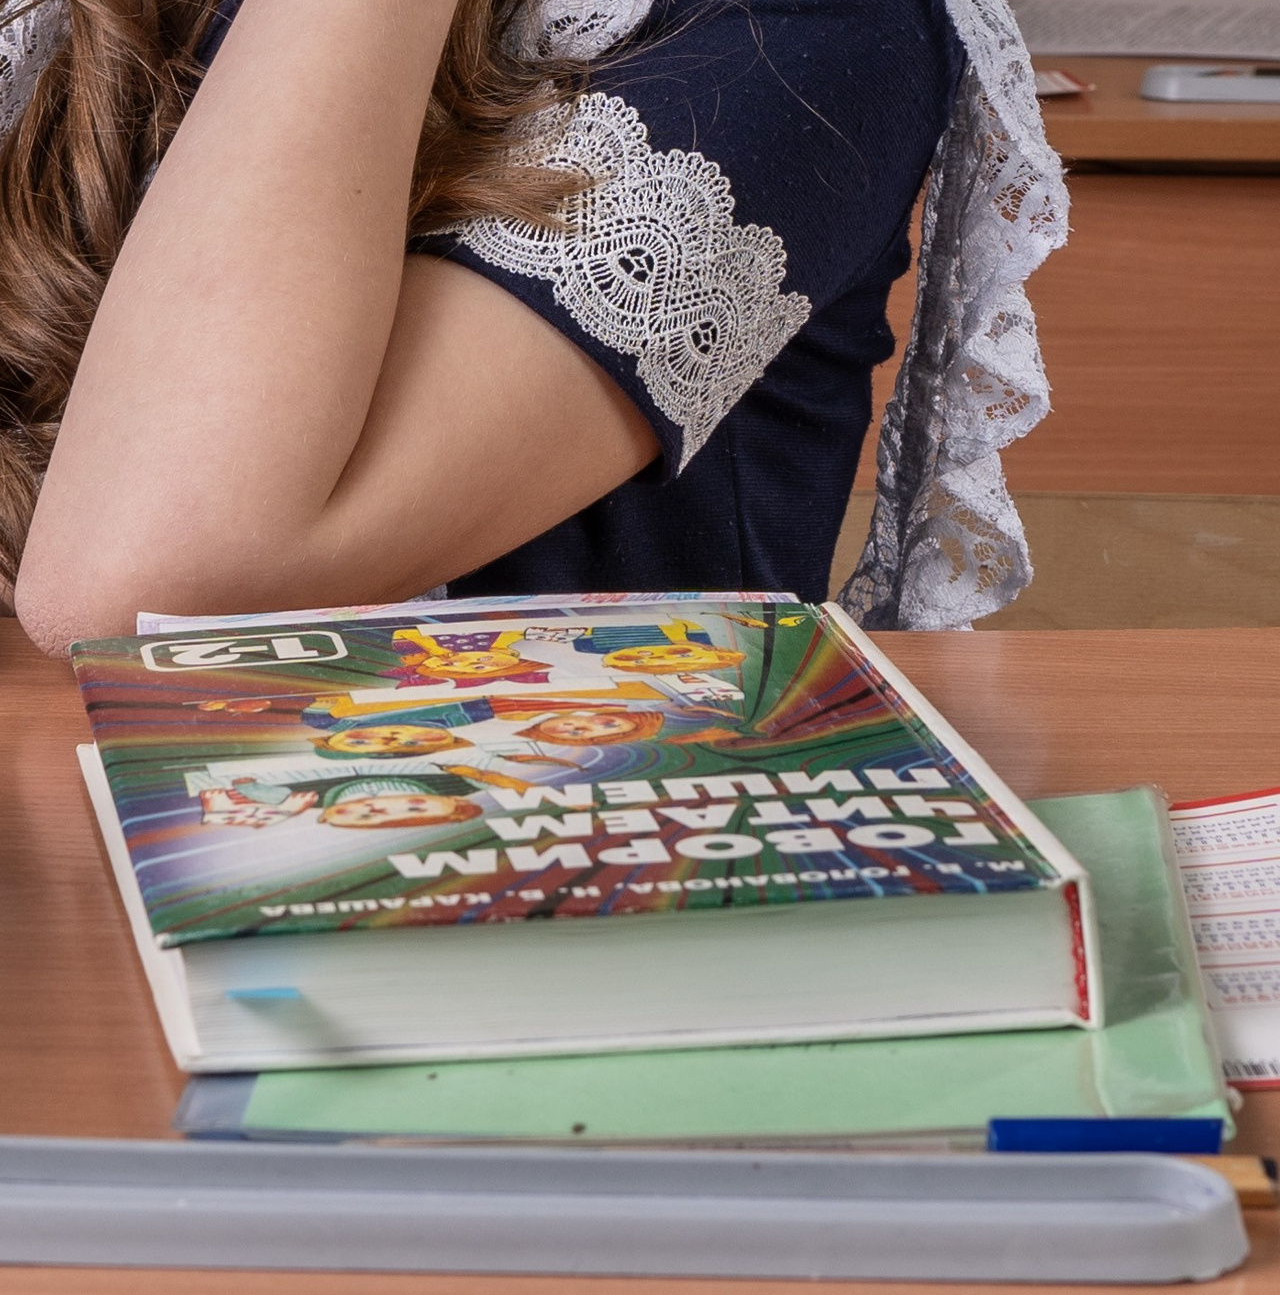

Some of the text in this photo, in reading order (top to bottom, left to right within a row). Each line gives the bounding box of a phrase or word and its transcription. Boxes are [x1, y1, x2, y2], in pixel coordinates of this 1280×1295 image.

[169, 637, 319, 665] 1-2
[485, 768, 953, 810] ПИШЕМ
[485, 794, 980, 842] ЧИТАЕМ
[386, 821, 999, 879] ГОВОРИМ
[259, 891, 491, 918] КАРАШЕВА
